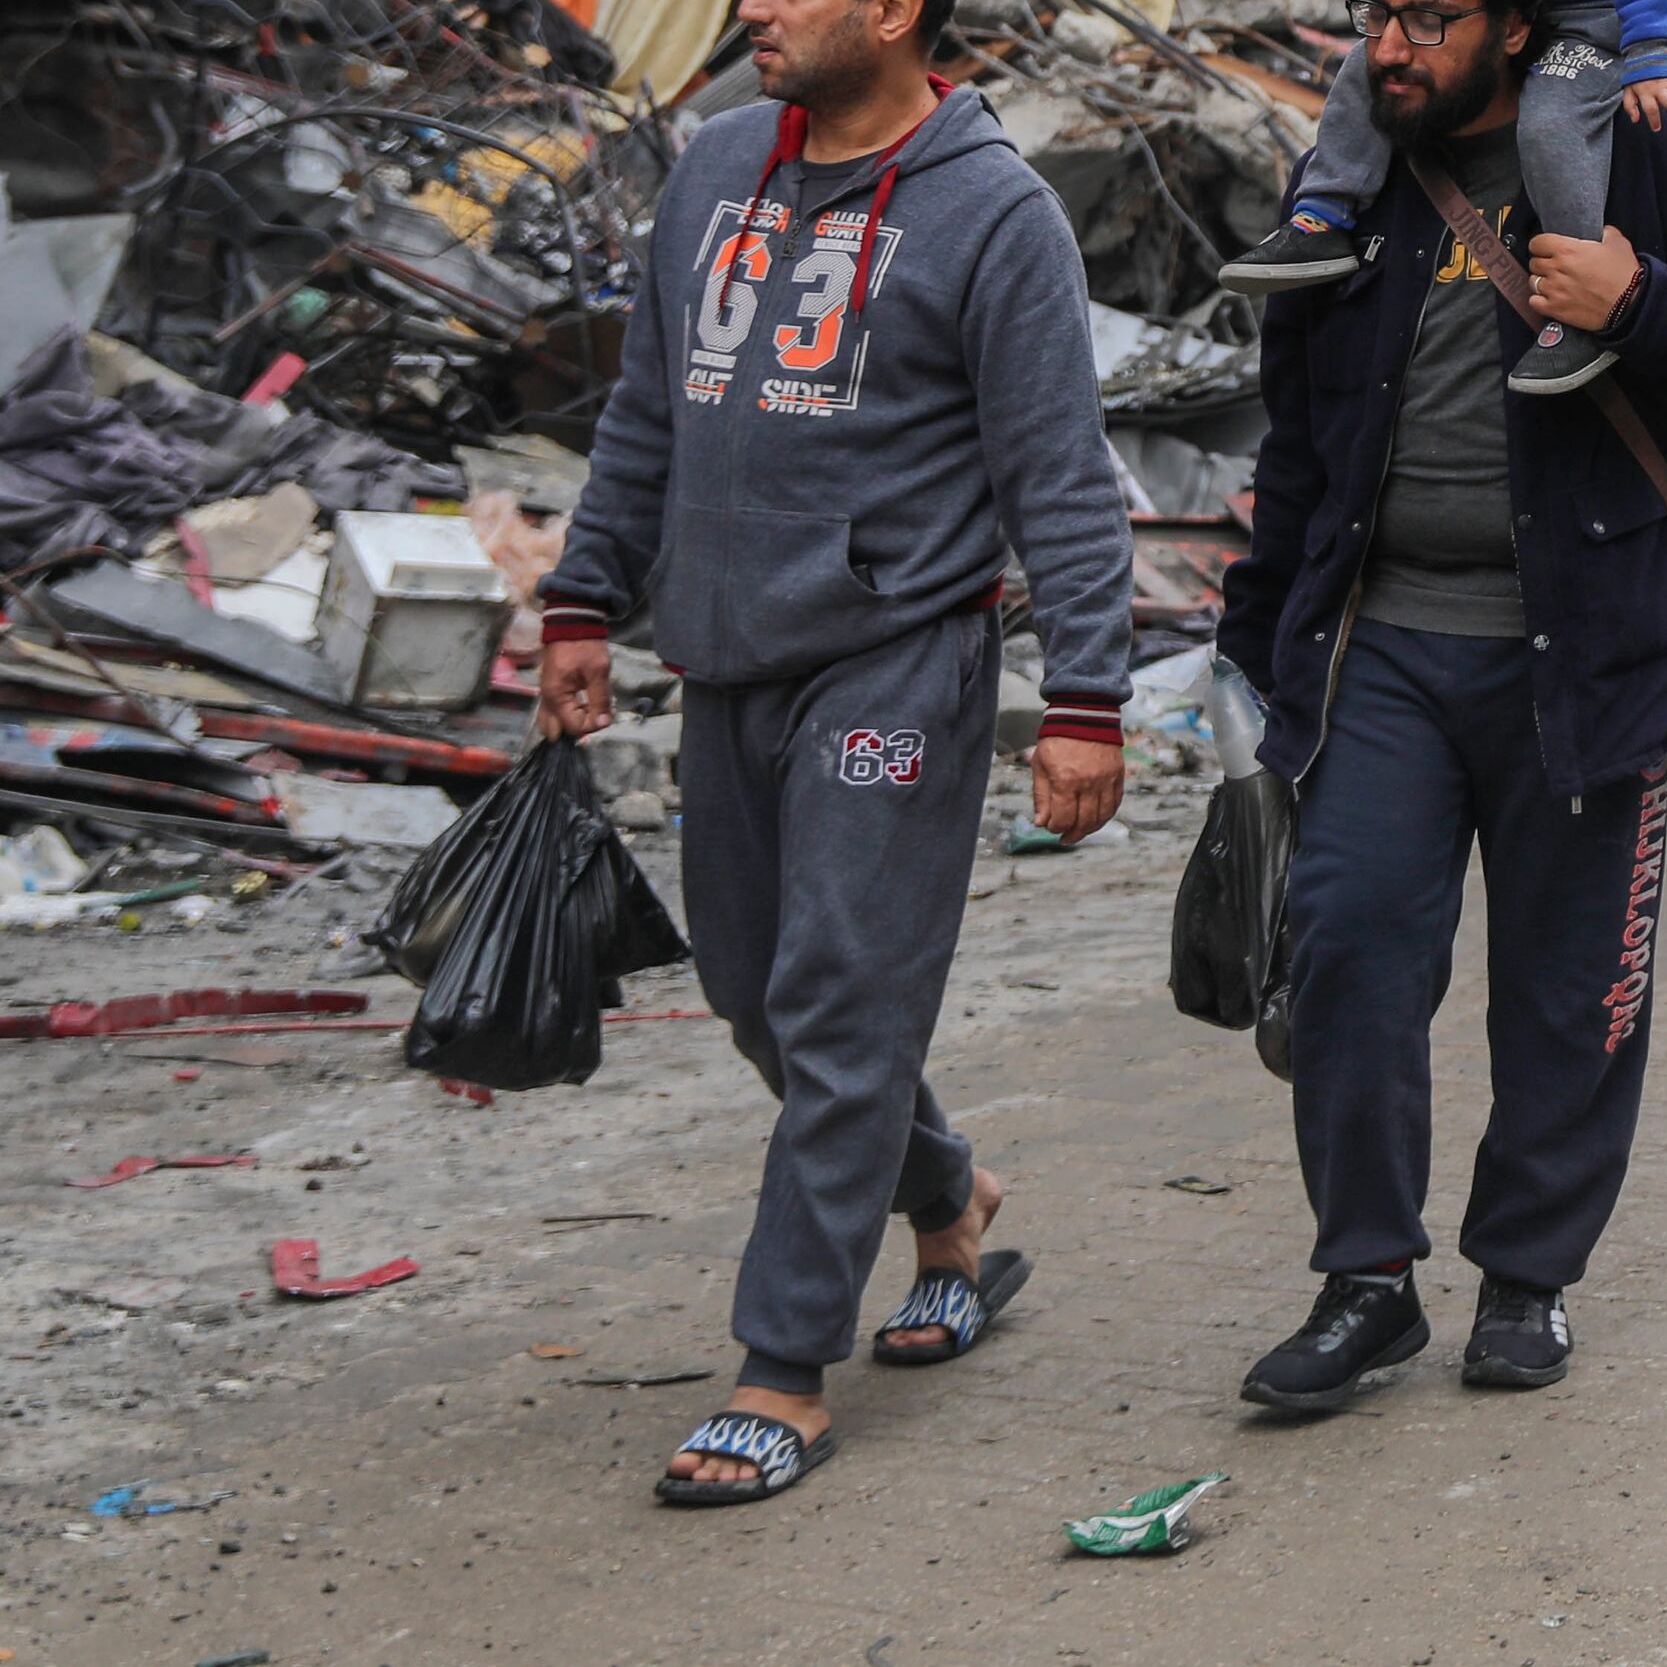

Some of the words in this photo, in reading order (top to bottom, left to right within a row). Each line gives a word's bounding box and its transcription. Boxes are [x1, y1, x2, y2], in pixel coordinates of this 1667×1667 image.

[1540, 64, 1579, 80] 1886
[814, 210, 883, 242] GUAR
[839, 728, 925, 785] 63
